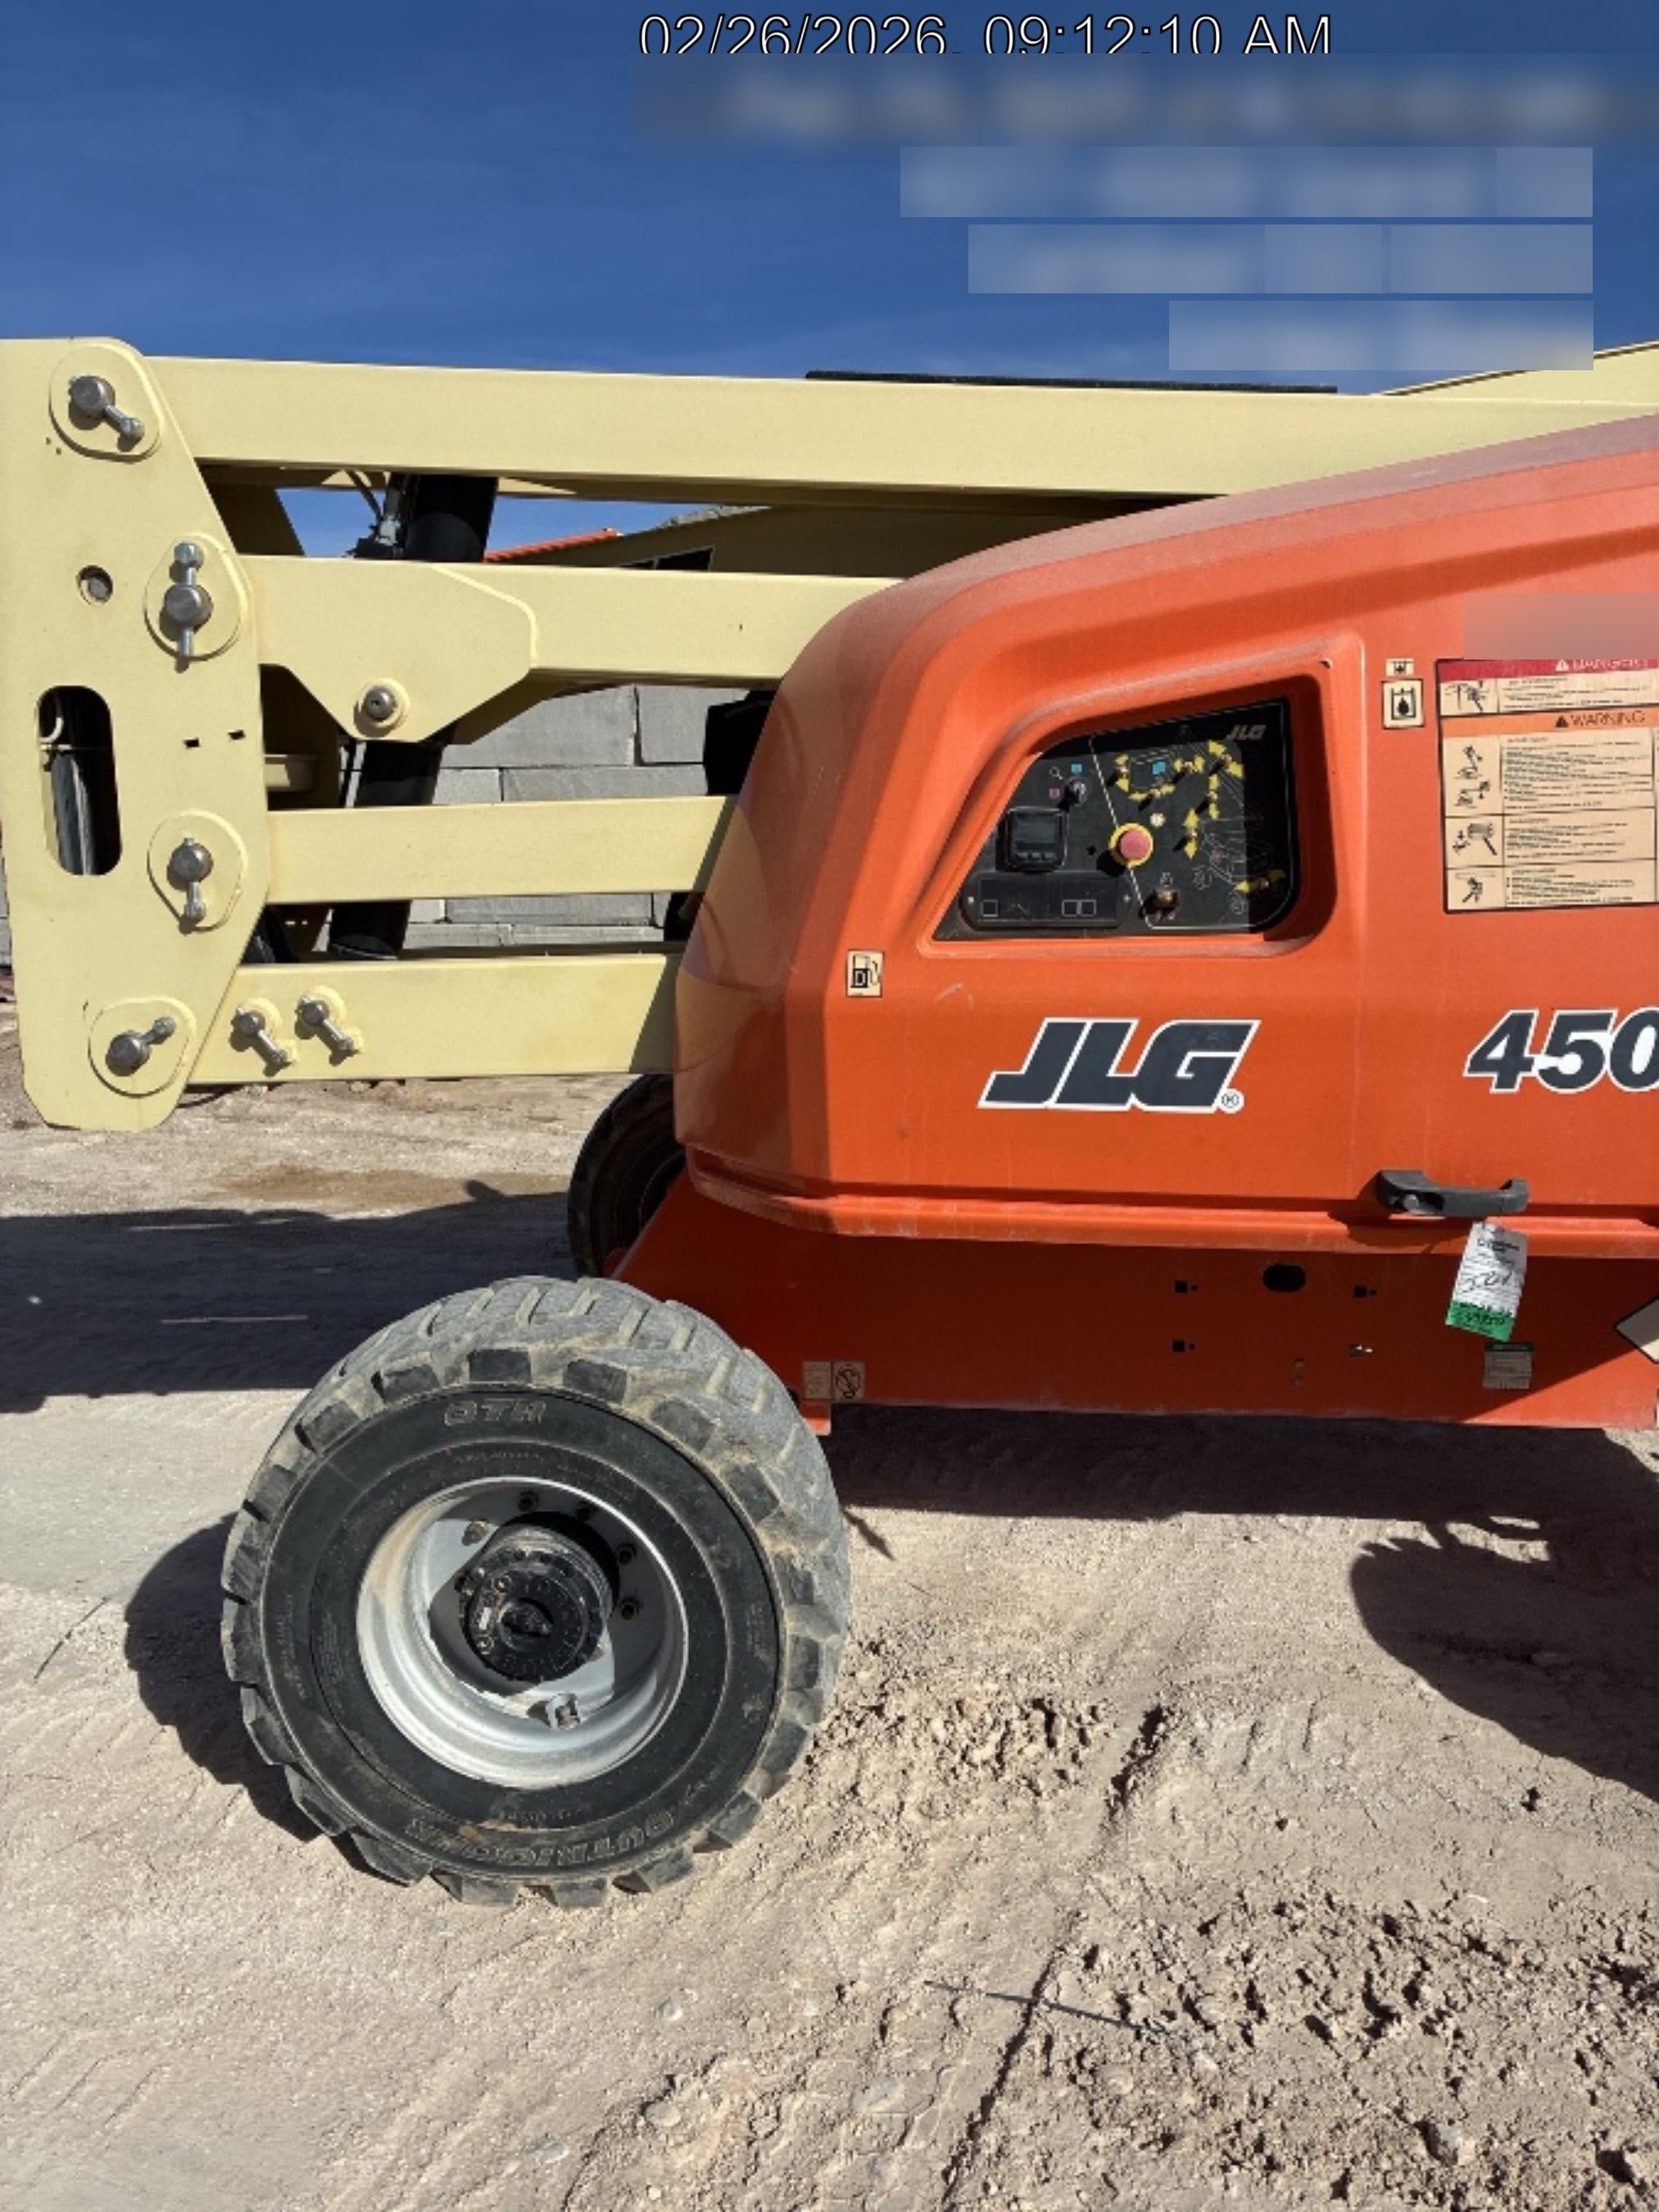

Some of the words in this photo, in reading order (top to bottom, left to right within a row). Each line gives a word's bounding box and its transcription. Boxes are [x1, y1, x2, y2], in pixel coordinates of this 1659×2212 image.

[1571, 709, 1645, 728] WARNING
[1226, 724, 1267, 741] JLG
[1462, 1007, 1659, 1095] 450
